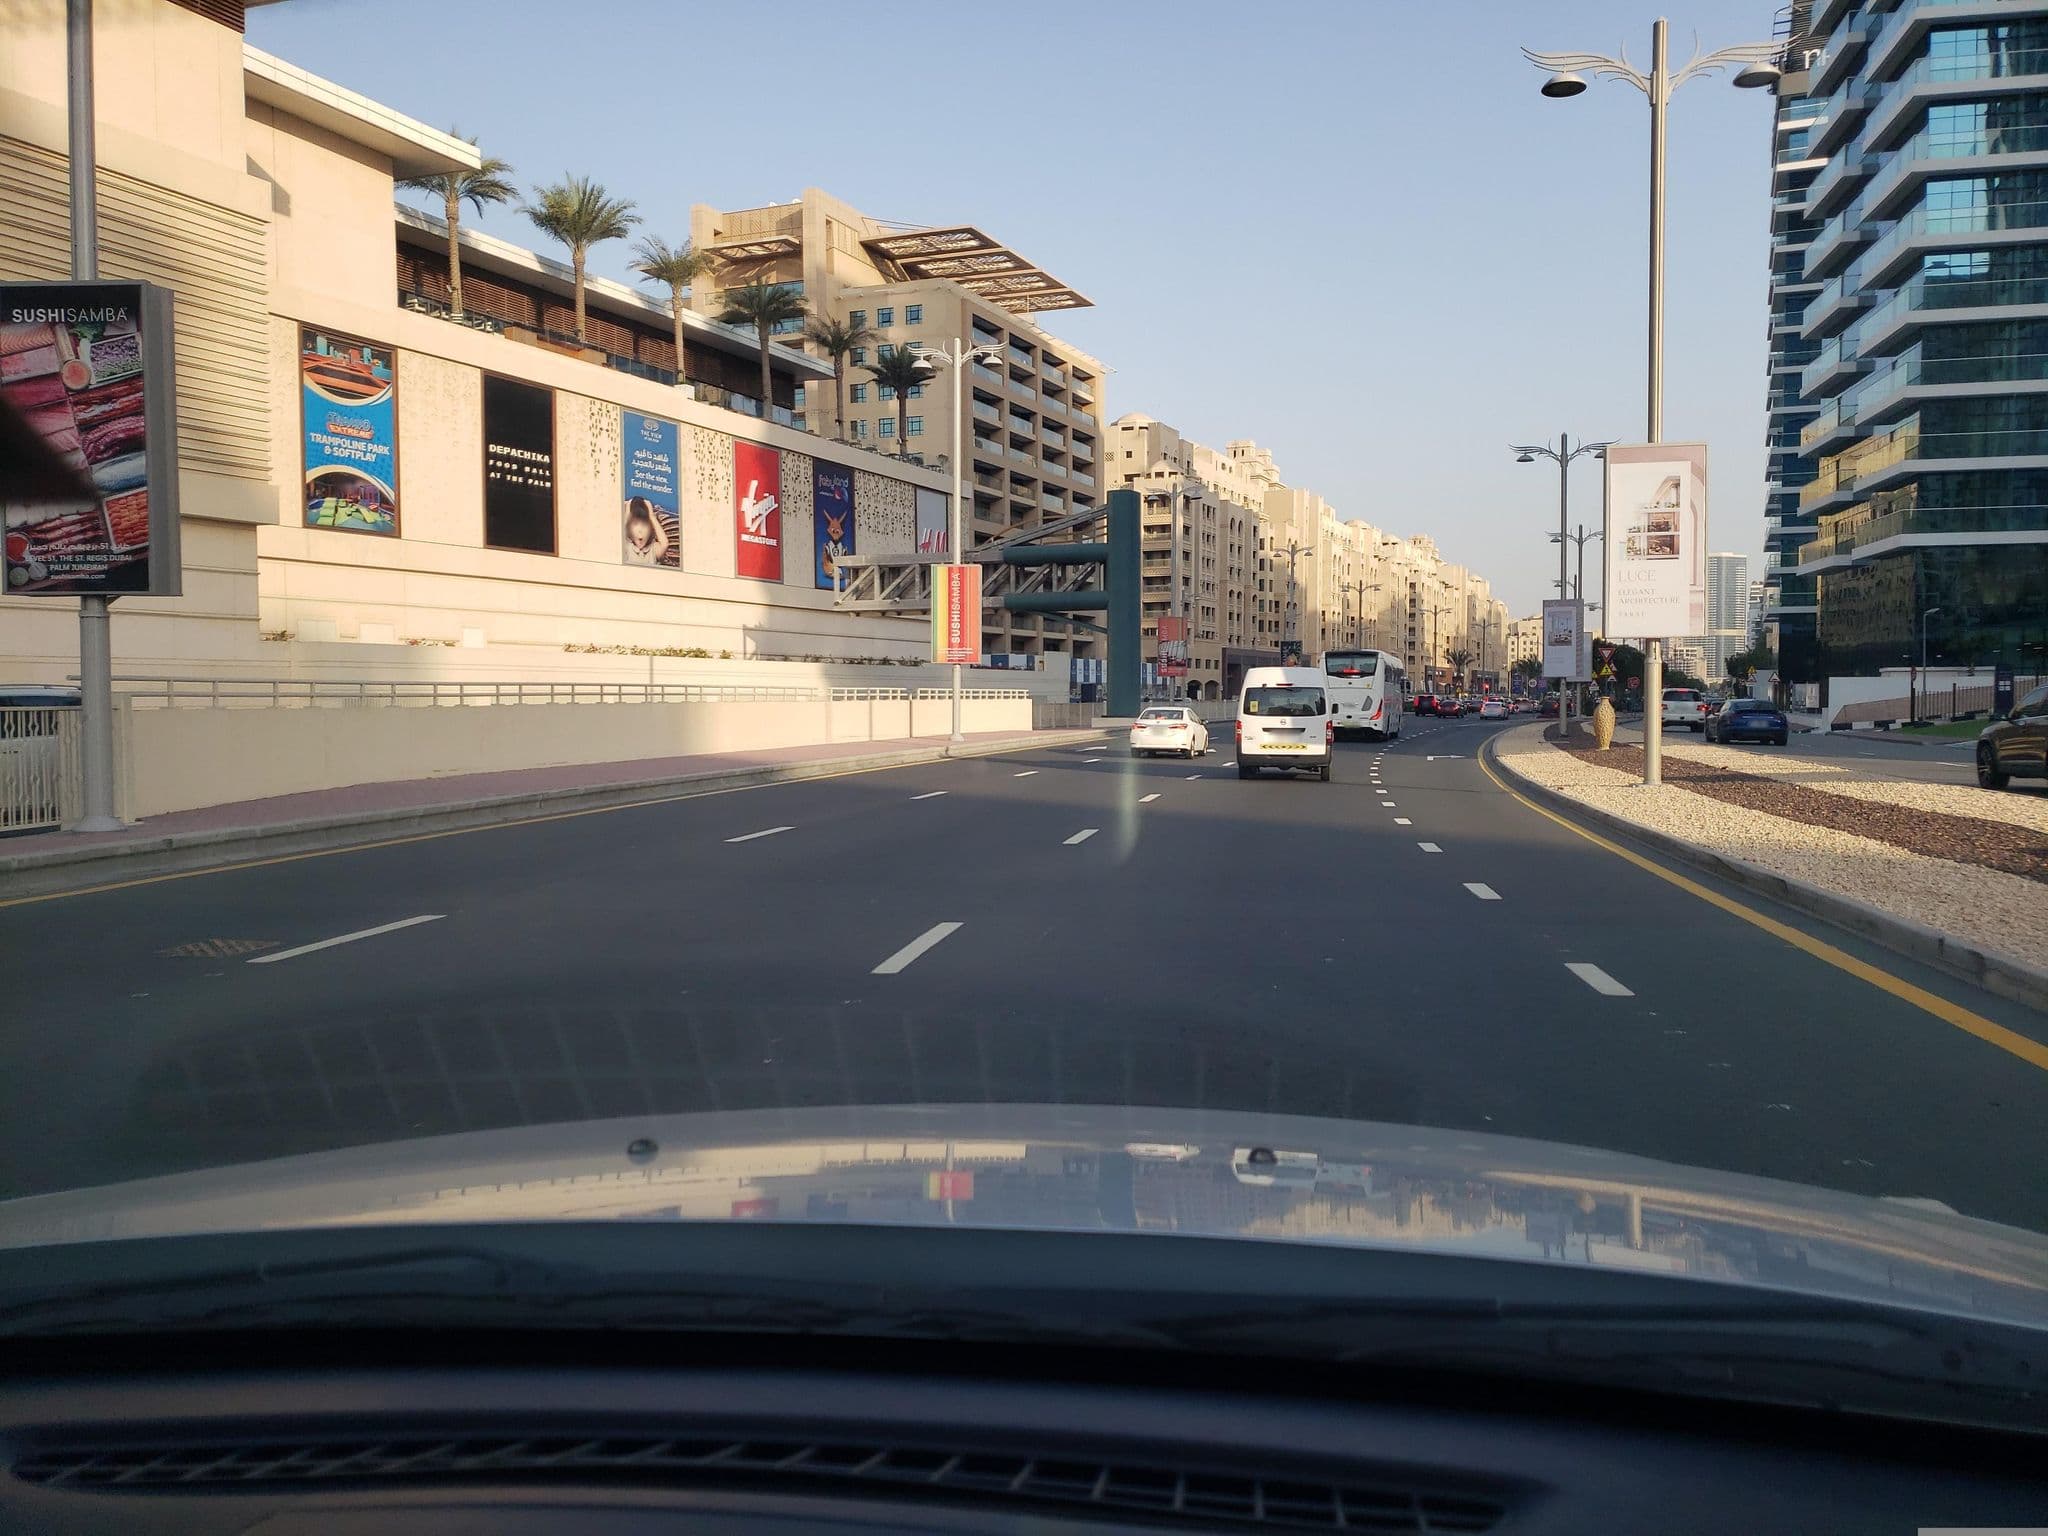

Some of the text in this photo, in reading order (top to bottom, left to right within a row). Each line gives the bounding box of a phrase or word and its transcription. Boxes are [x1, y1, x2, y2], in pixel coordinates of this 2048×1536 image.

[12, 307, 127, 322] SUSHISAMBA
[310, 432, 390, 455] TRAMPOLINE PARK
[324, 446, 376, 462] & SOFTPLAY
[488, 444, 550, 463] DEPACHIKA
[506, 475, 524, 483] THE
[527, 478, 551, 488] PALM
[60, 554, 73, 562] THE
[87, 554, 108, 562] REGIS
[109, 554, 131, 562] DUBAI
[49, 563, 70, 571] PALM
[1618, 570, 1656, 583] LUCE
[1618, 588, 1656, 596] ELEGANT
[1619, 595, 1680, 604] ARCHITECTURE
[951, 573, 961, 644] SUSHISAMBA
